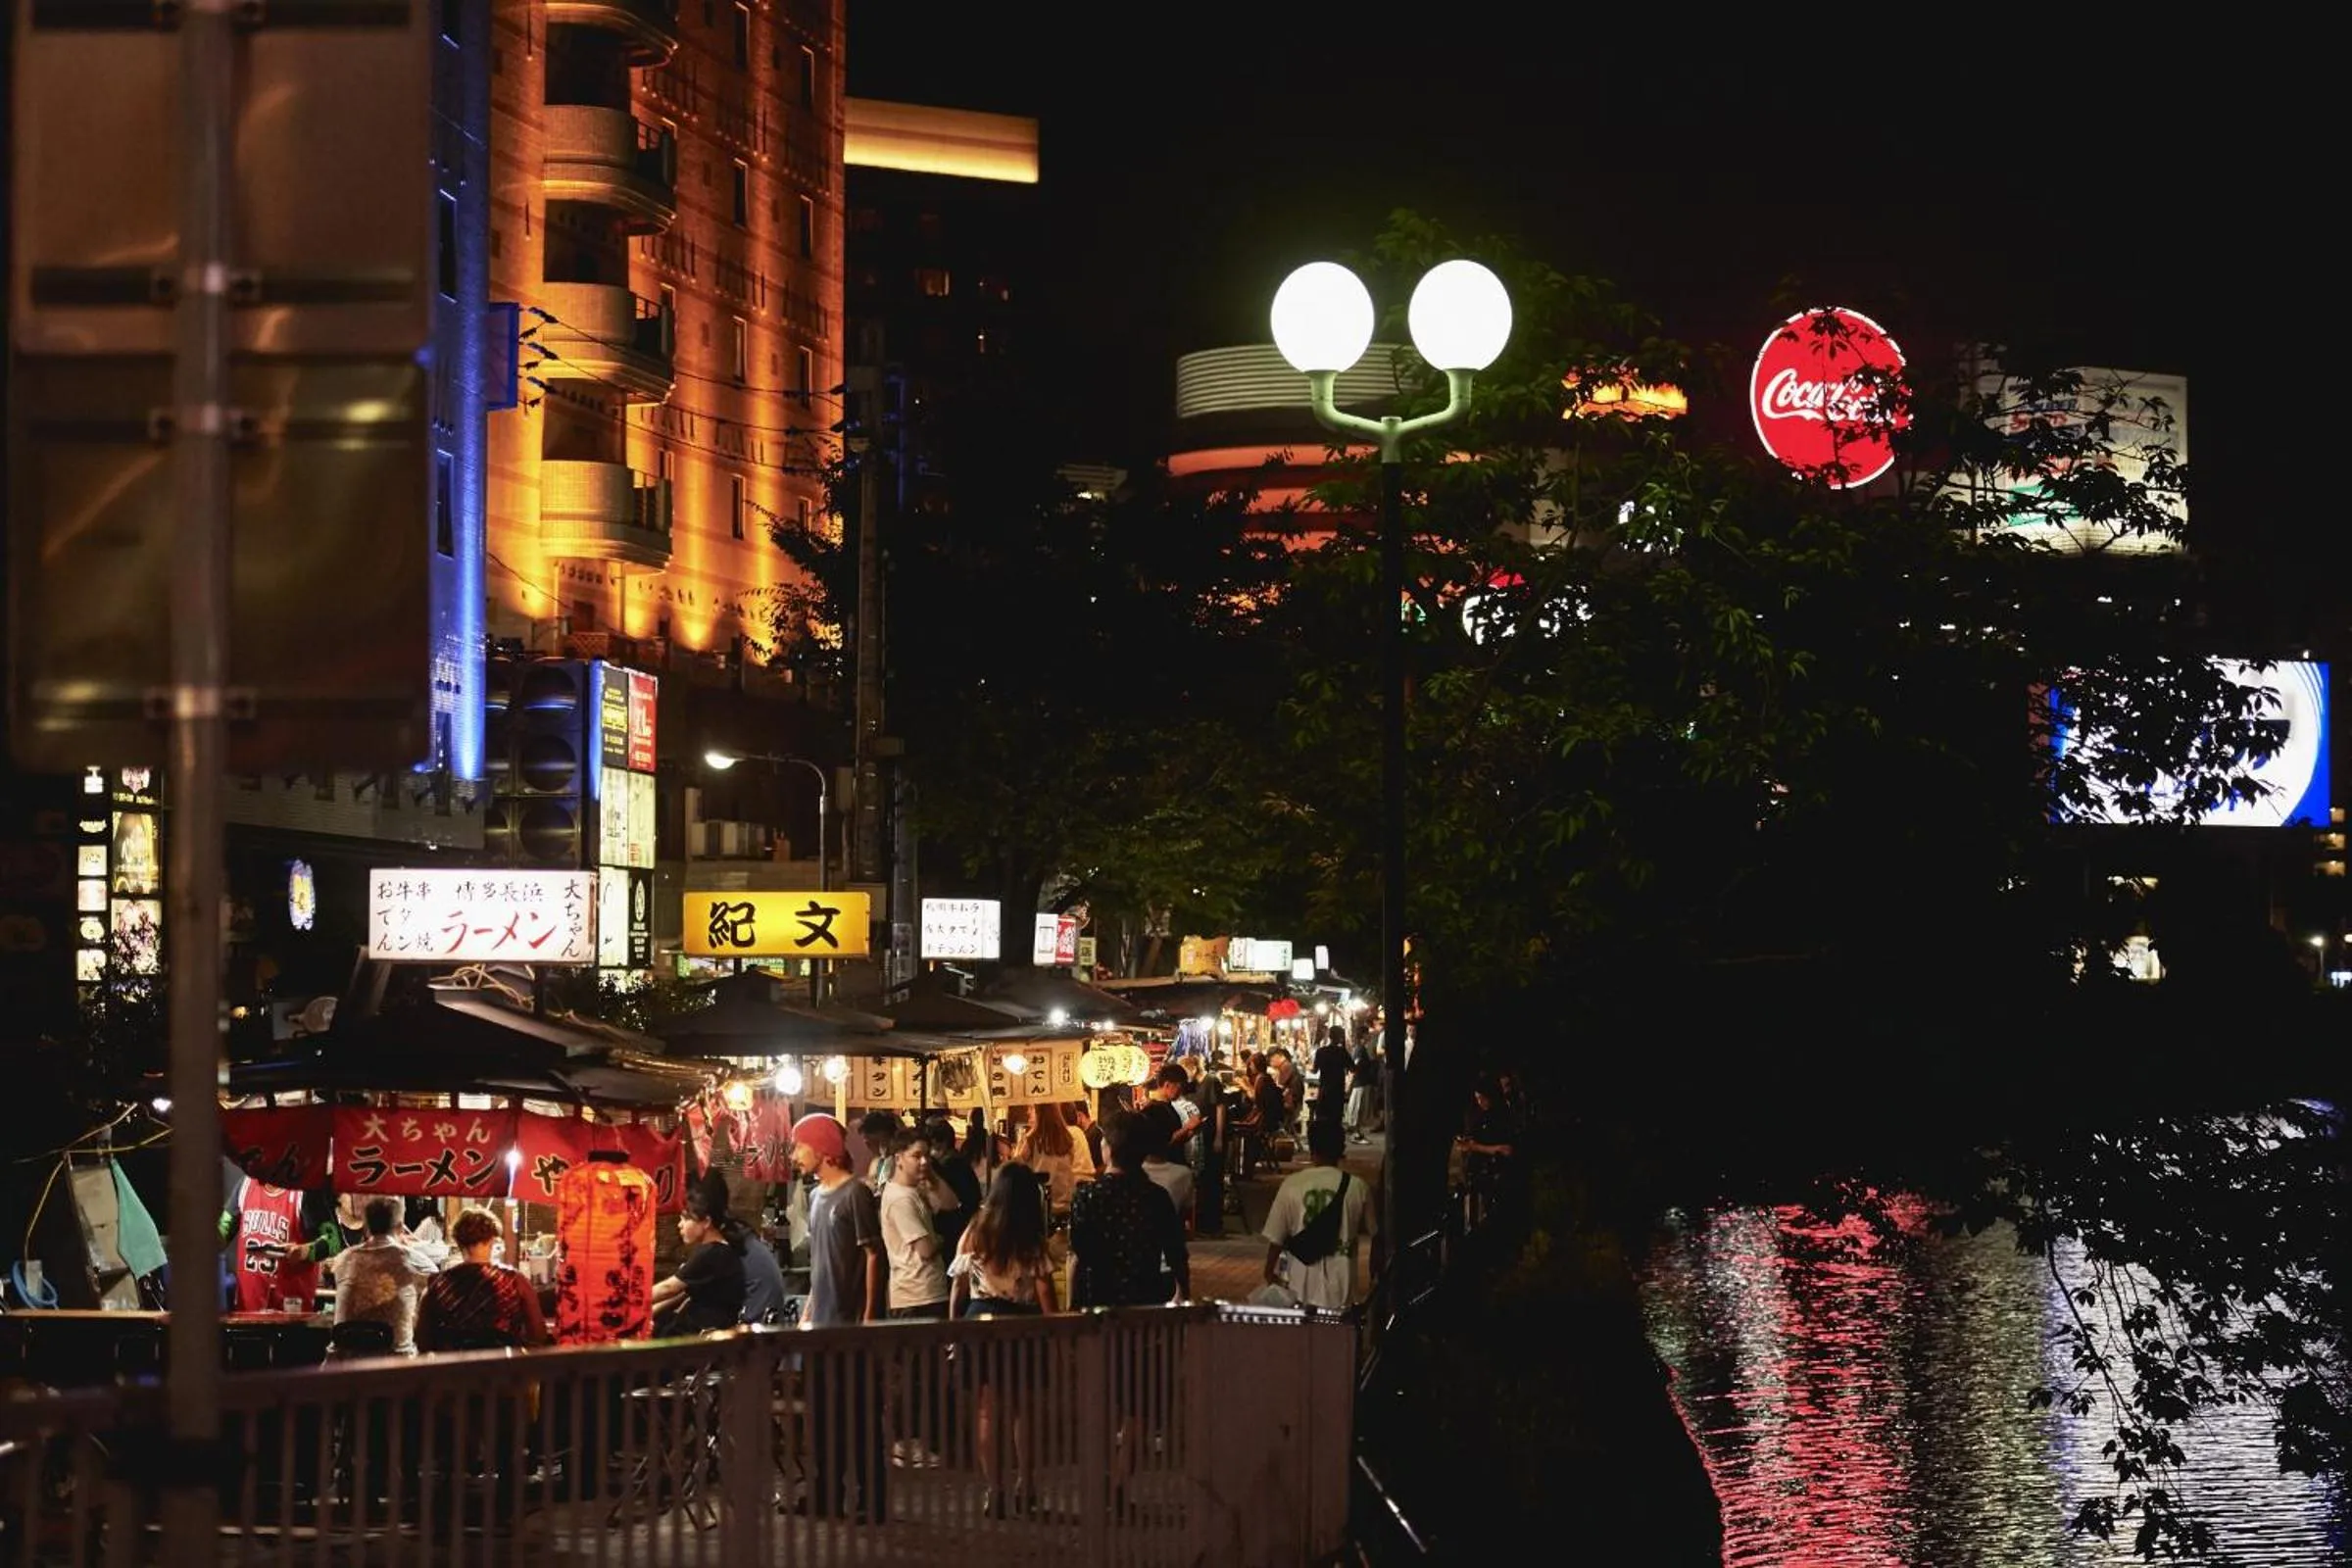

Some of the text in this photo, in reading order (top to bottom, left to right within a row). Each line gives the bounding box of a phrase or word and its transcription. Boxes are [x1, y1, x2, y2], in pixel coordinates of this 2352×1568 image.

[440, 909, 557, 955] ラーメン
[561, 879, 583, 957] 大ちゃん
[361, 1112, 491, 1145] 大ちゃん
[348, 1144, 499, 1191] ラーメン
[241, 1208, 290, 1243] BULLS
